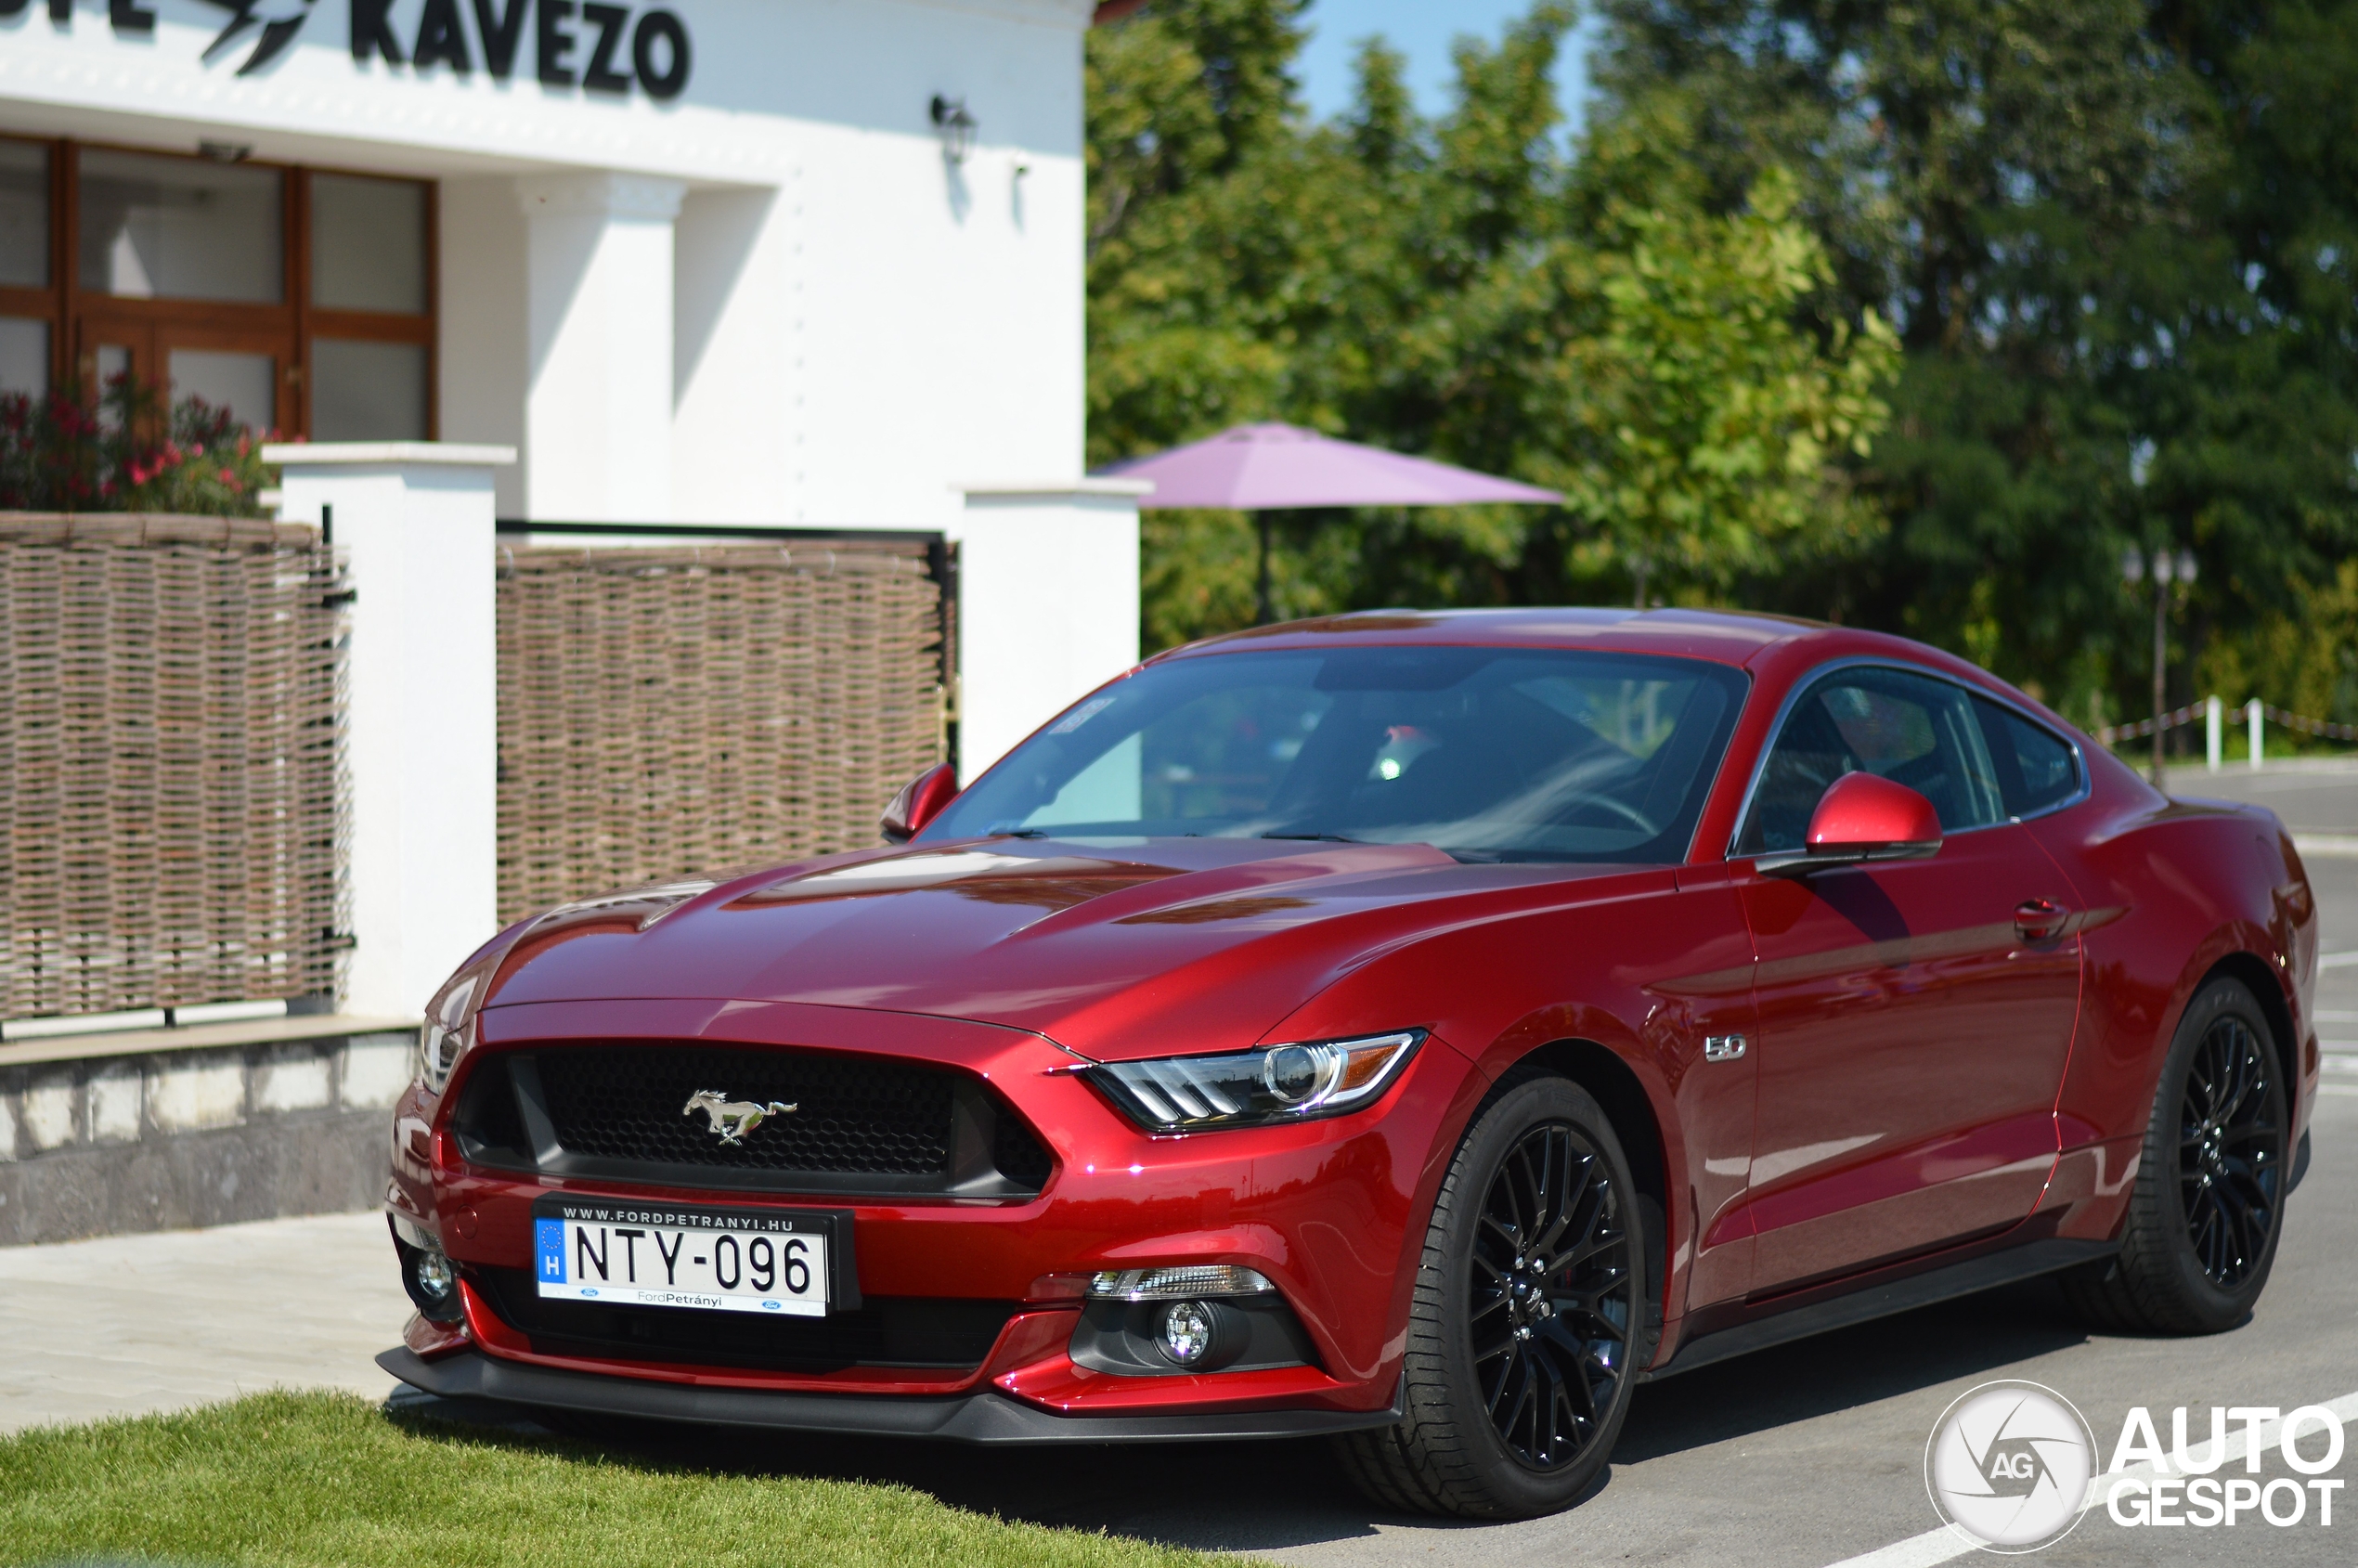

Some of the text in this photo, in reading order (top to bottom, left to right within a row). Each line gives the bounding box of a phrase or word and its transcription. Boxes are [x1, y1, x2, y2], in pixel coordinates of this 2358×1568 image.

[564, 1207, 795, 1232] WWW.FORDPETRANYI.HU
[545, 1255, 560, 1276] H
[575, 1225, 811, 1294] NTY-096
[638, 1291, 722, 1307] FordPetrányi
